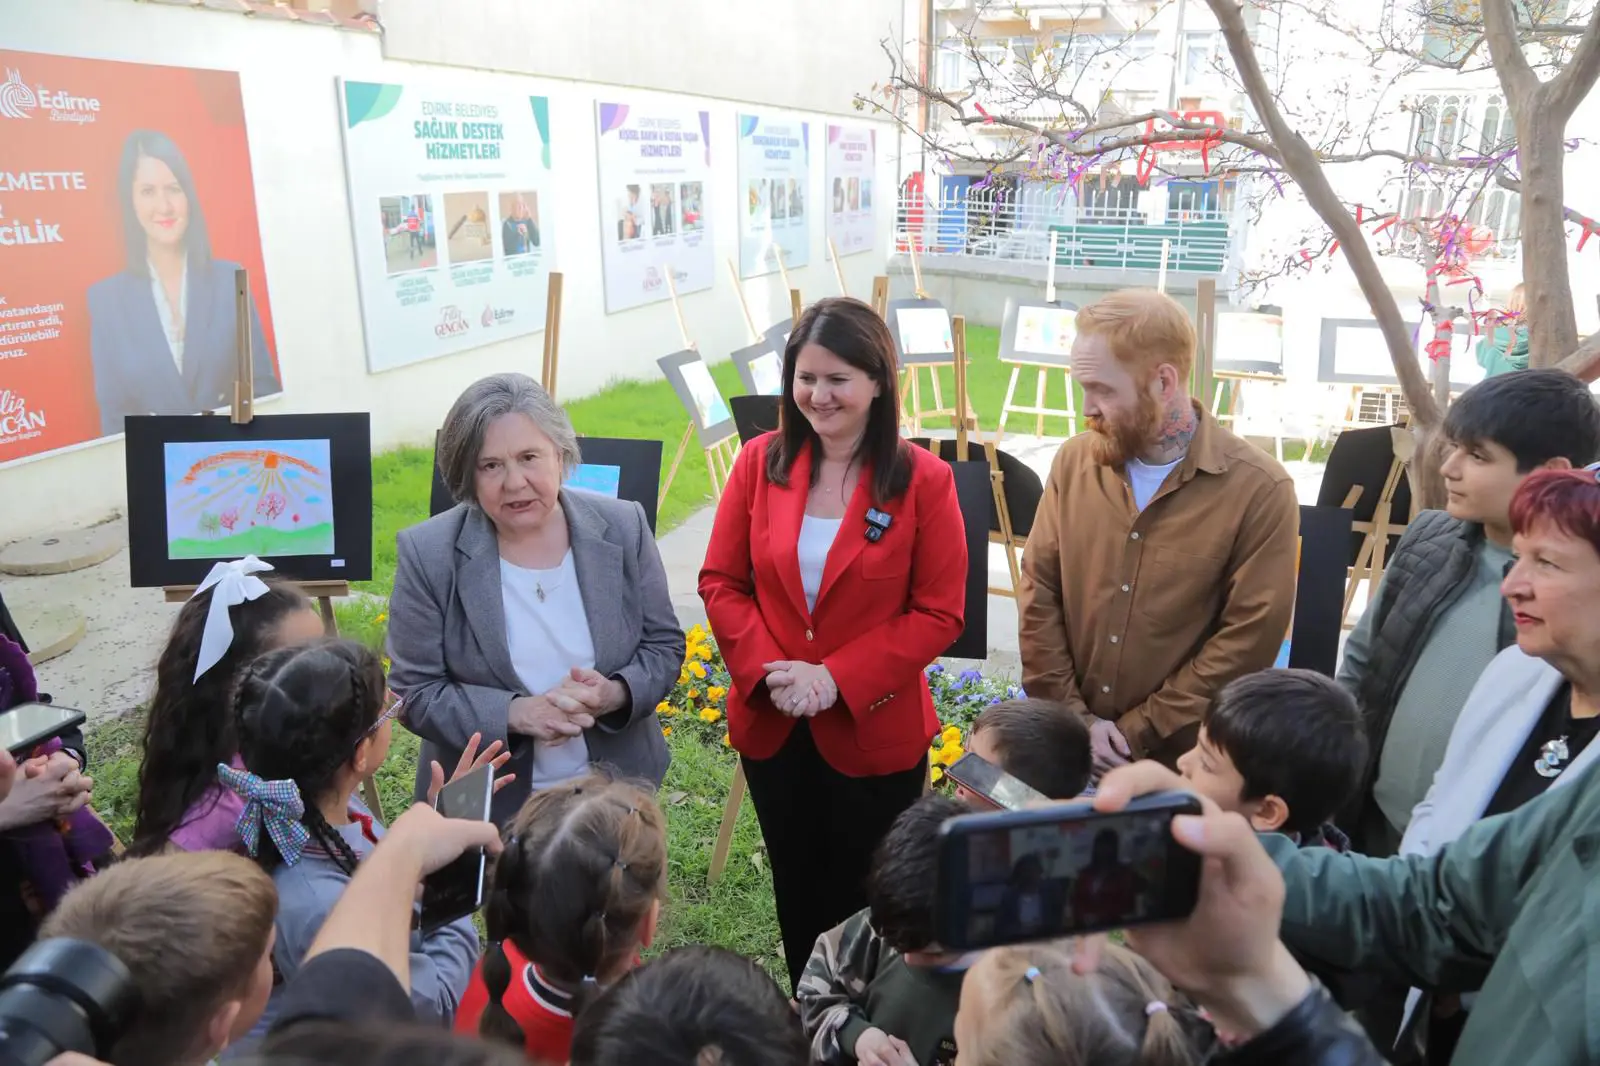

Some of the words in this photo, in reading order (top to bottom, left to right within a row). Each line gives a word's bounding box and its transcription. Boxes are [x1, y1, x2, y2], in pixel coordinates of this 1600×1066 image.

[38, 89, 101, 111] Edirne
[414, 116, 458, 139] SAĞLIK
[462, 122, 504, 140] DESTEK
[426, 142, 501, 160] HİZMETLERİ
[0, 410, 46, 436] CAN
